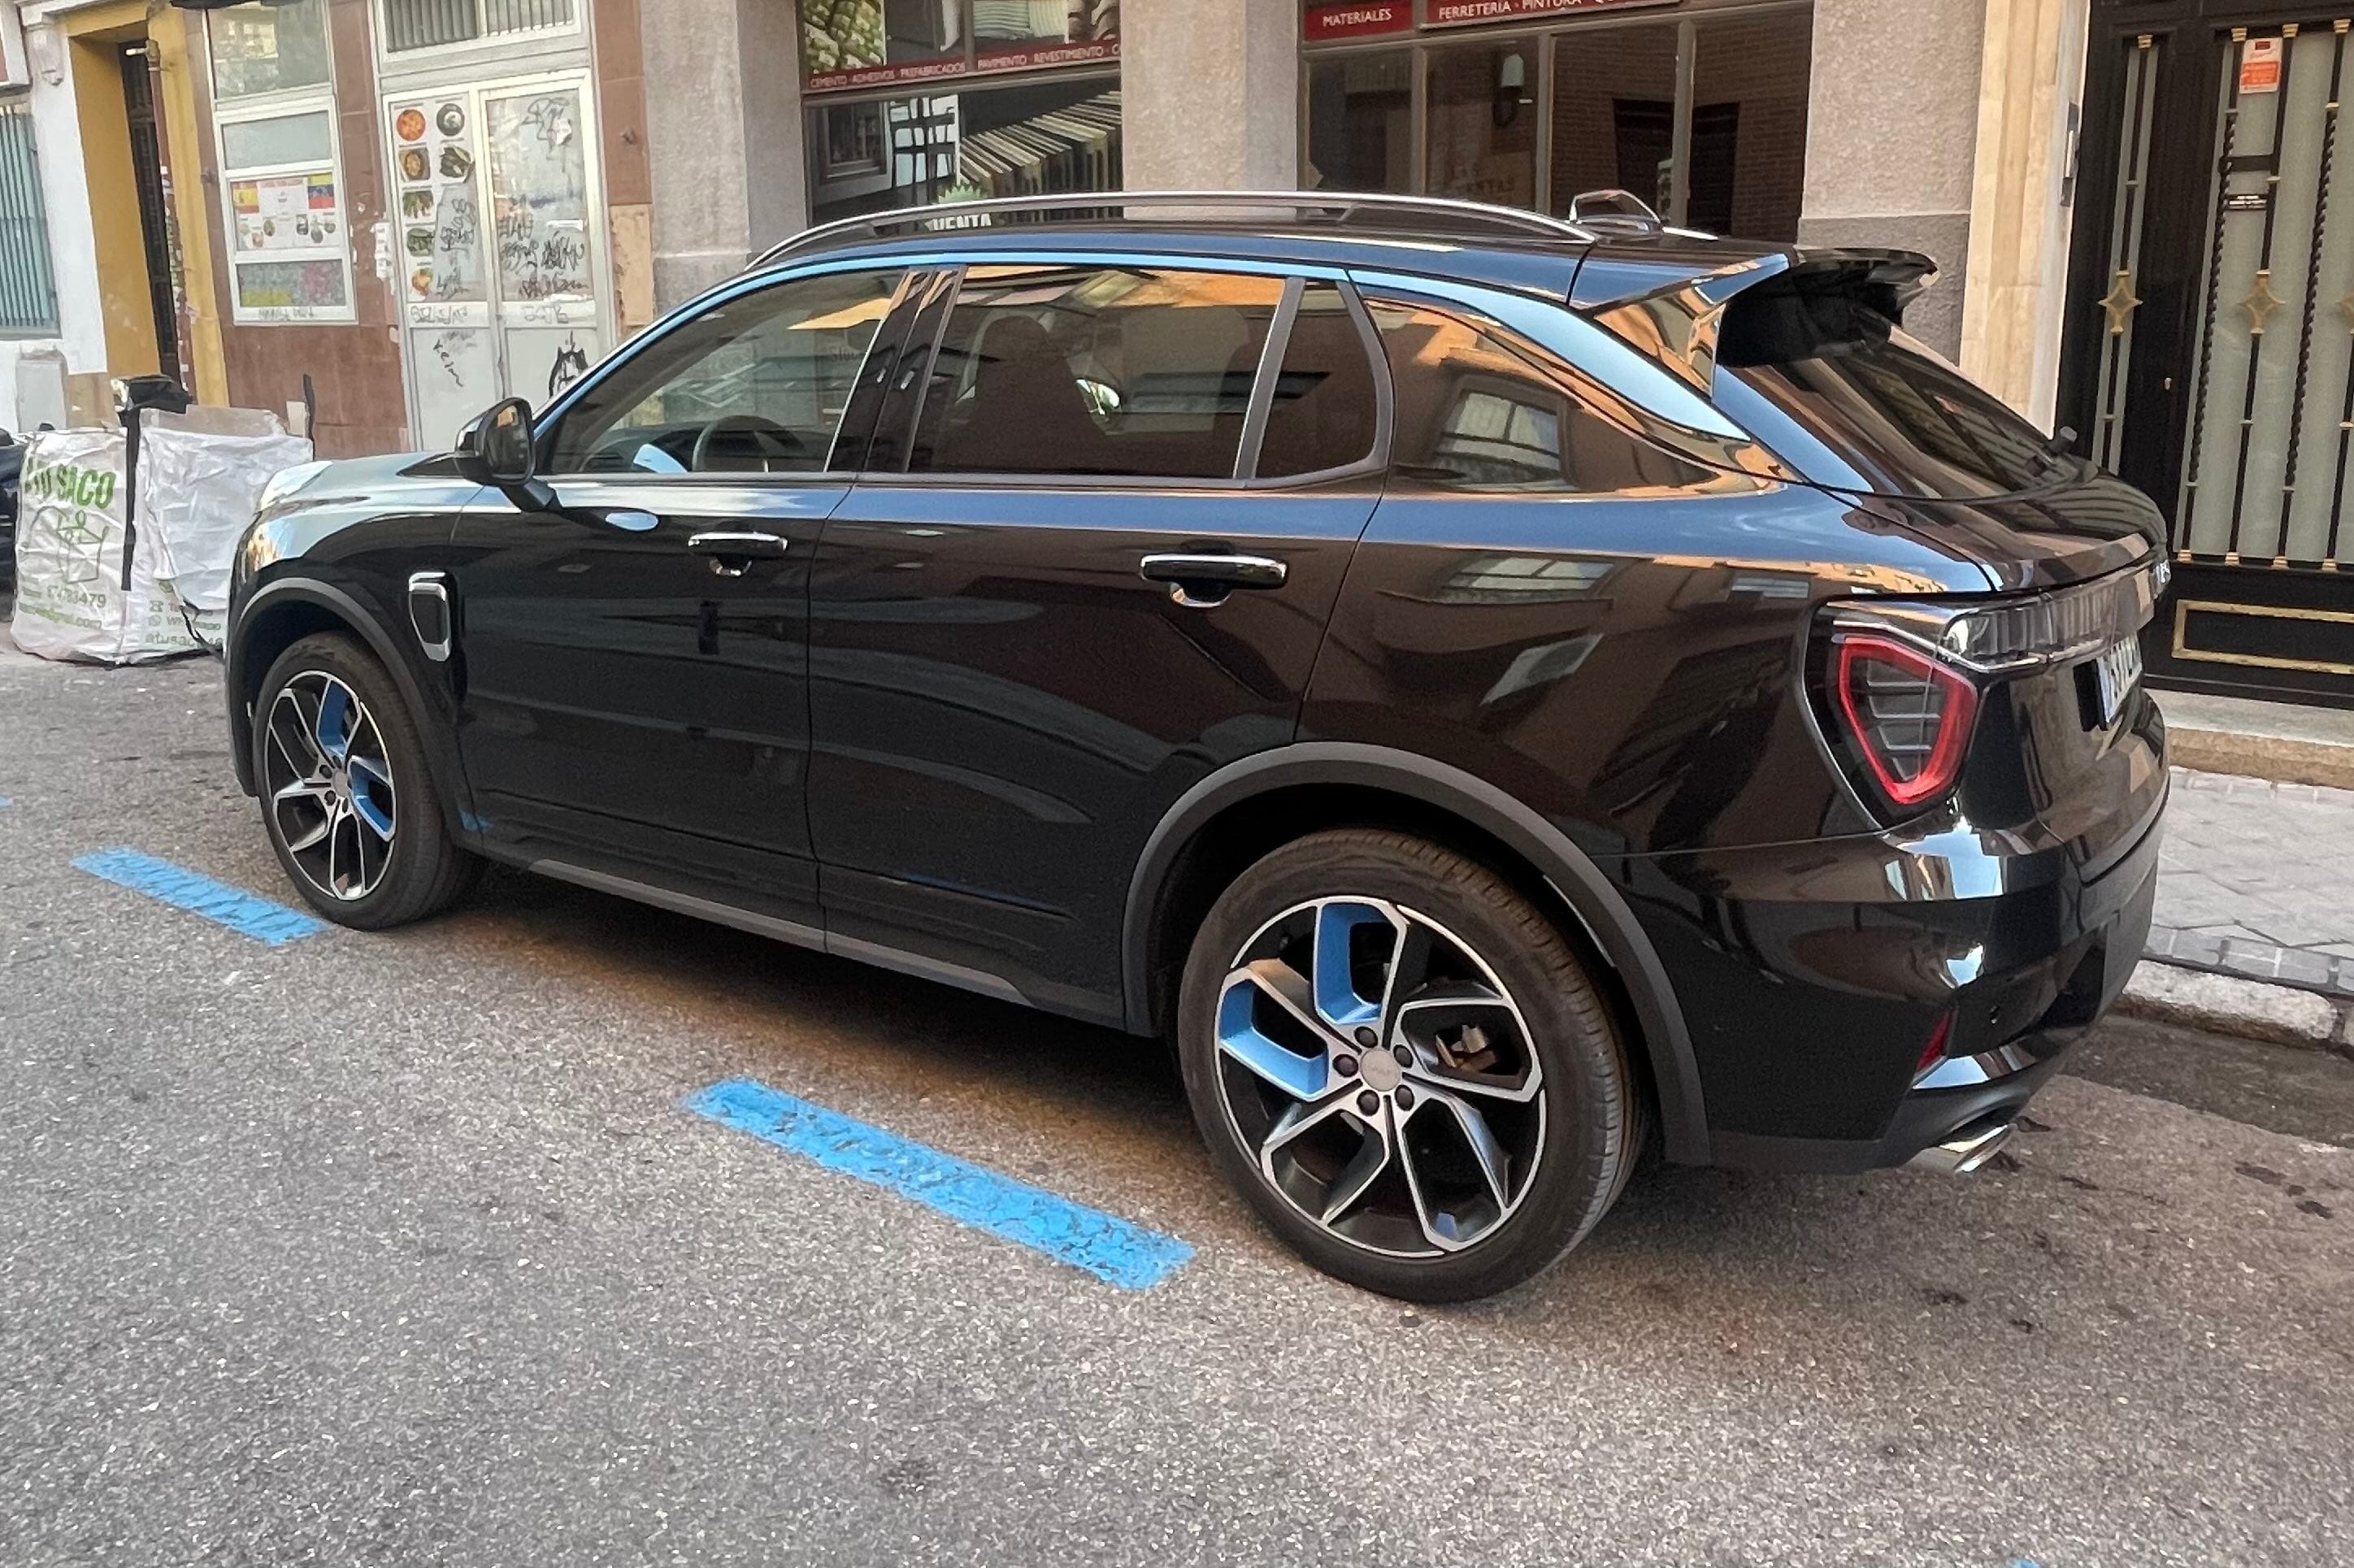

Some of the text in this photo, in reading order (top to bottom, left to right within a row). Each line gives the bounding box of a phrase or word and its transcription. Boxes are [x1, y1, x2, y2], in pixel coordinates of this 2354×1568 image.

[1322, 8, 1392, 27] MATERIALES
[1439, 2, 1511, 20] FERRETERIA
[1034, 46, 1104, 63] REVESTIMIENTO
